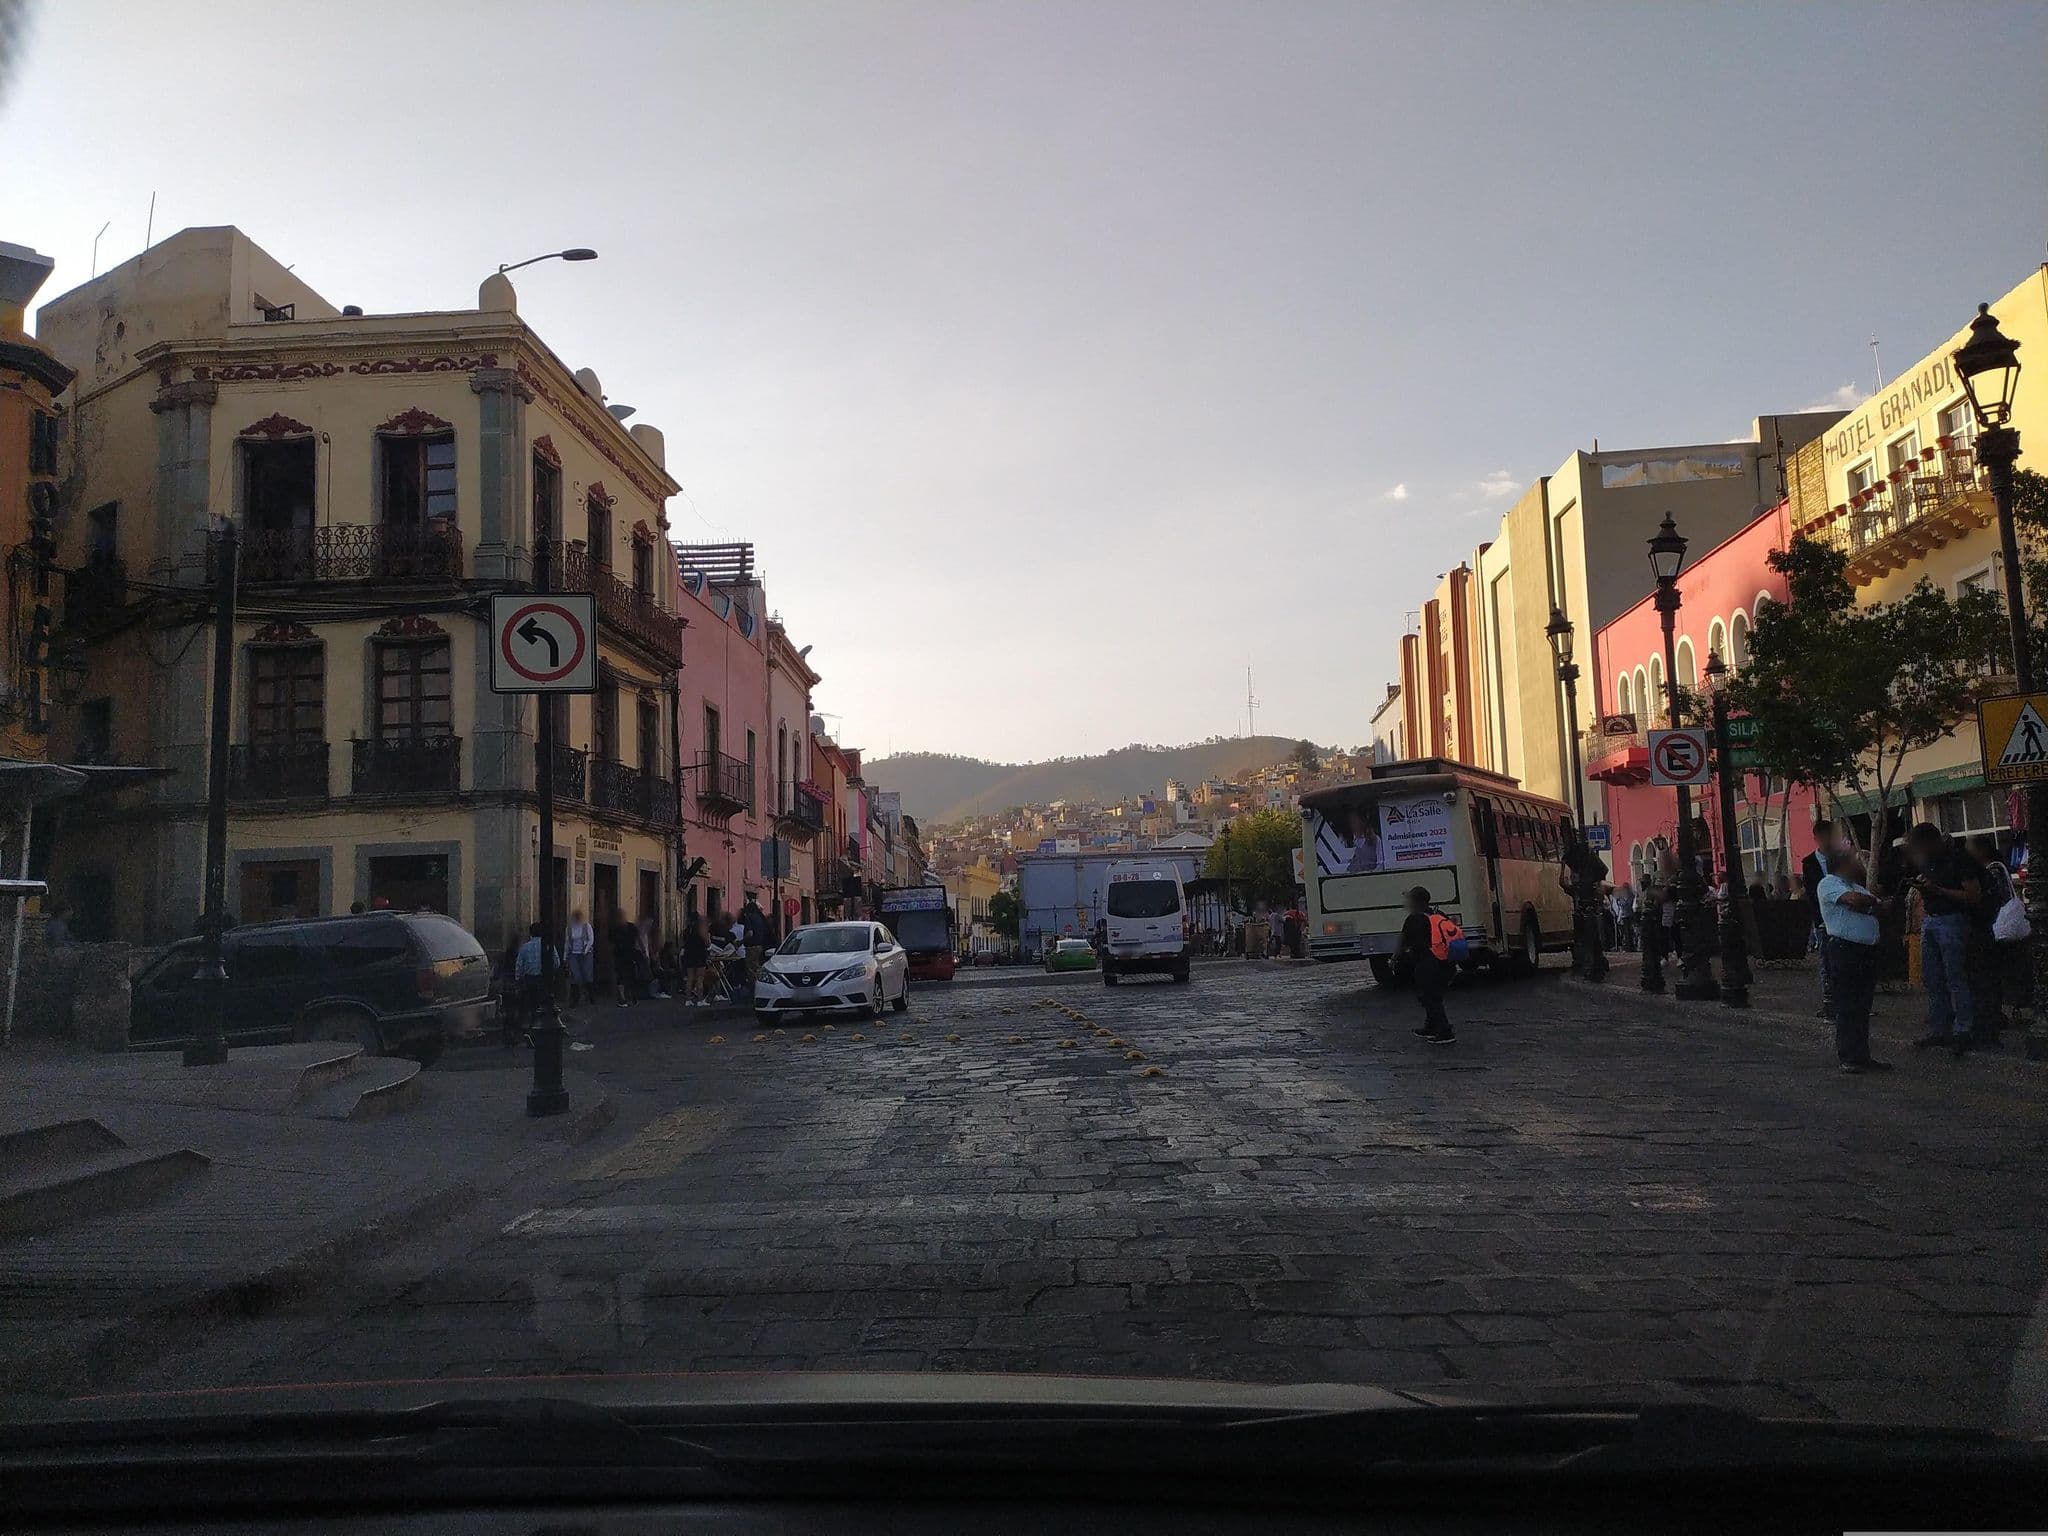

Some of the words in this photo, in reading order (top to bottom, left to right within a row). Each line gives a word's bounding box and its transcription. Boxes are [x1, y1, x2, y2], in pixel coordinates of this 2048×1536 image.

[1828, 414, 1876, 465] HOTEL
[1880, 355, 1952, 430] GRANADI
[1418, 805, 1442, 817] Salle
[1387, 831, 1428, 841] Admisiones
[1429, 828, 1447, 836] 2023
